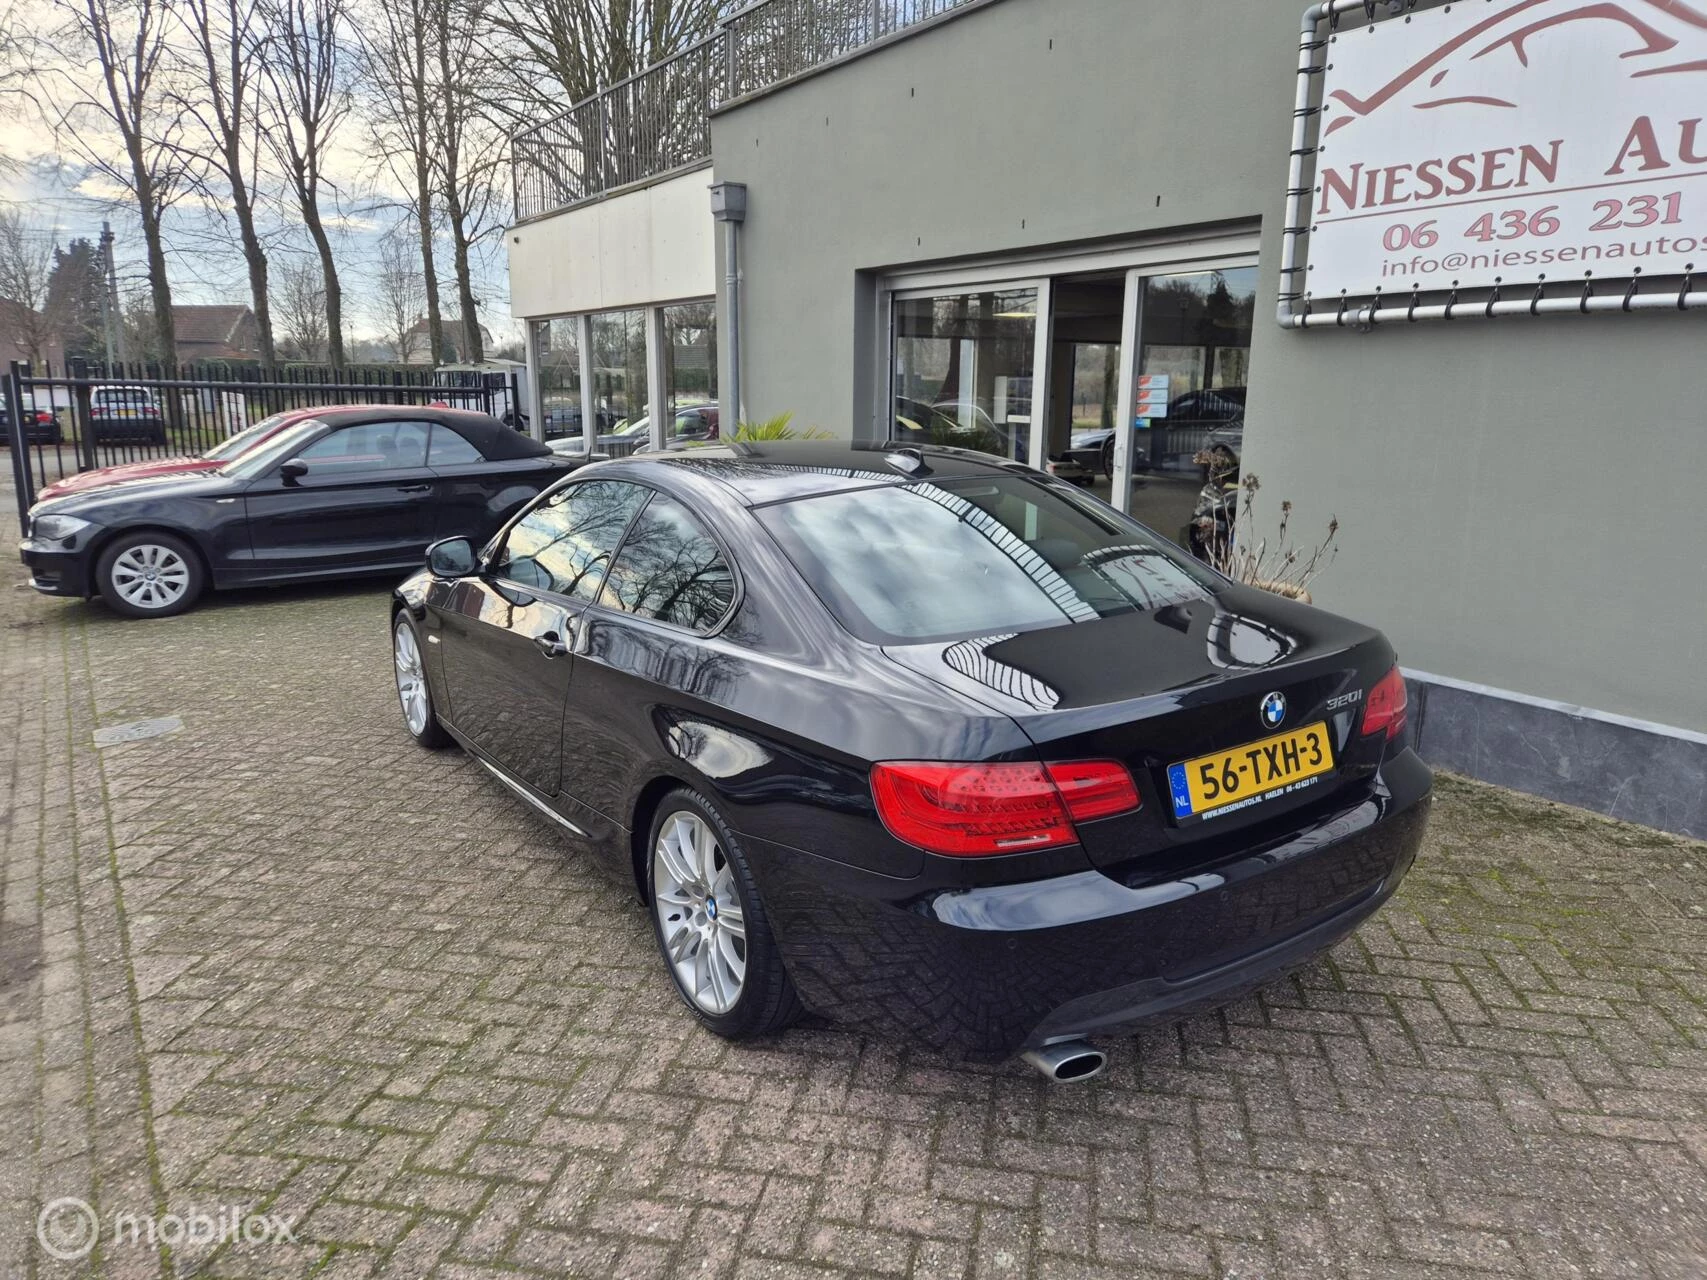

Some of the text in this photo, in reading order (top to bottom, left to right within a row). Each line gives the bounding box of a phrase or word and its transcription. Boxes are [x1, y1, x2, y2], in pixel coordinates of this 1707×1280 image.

[1317, 140, 1564, 214] NIESSEN
[1382, 191, 1683, 252] 06 436 231
[1175, 732, 1323, 809] NL 56-TXH-3
